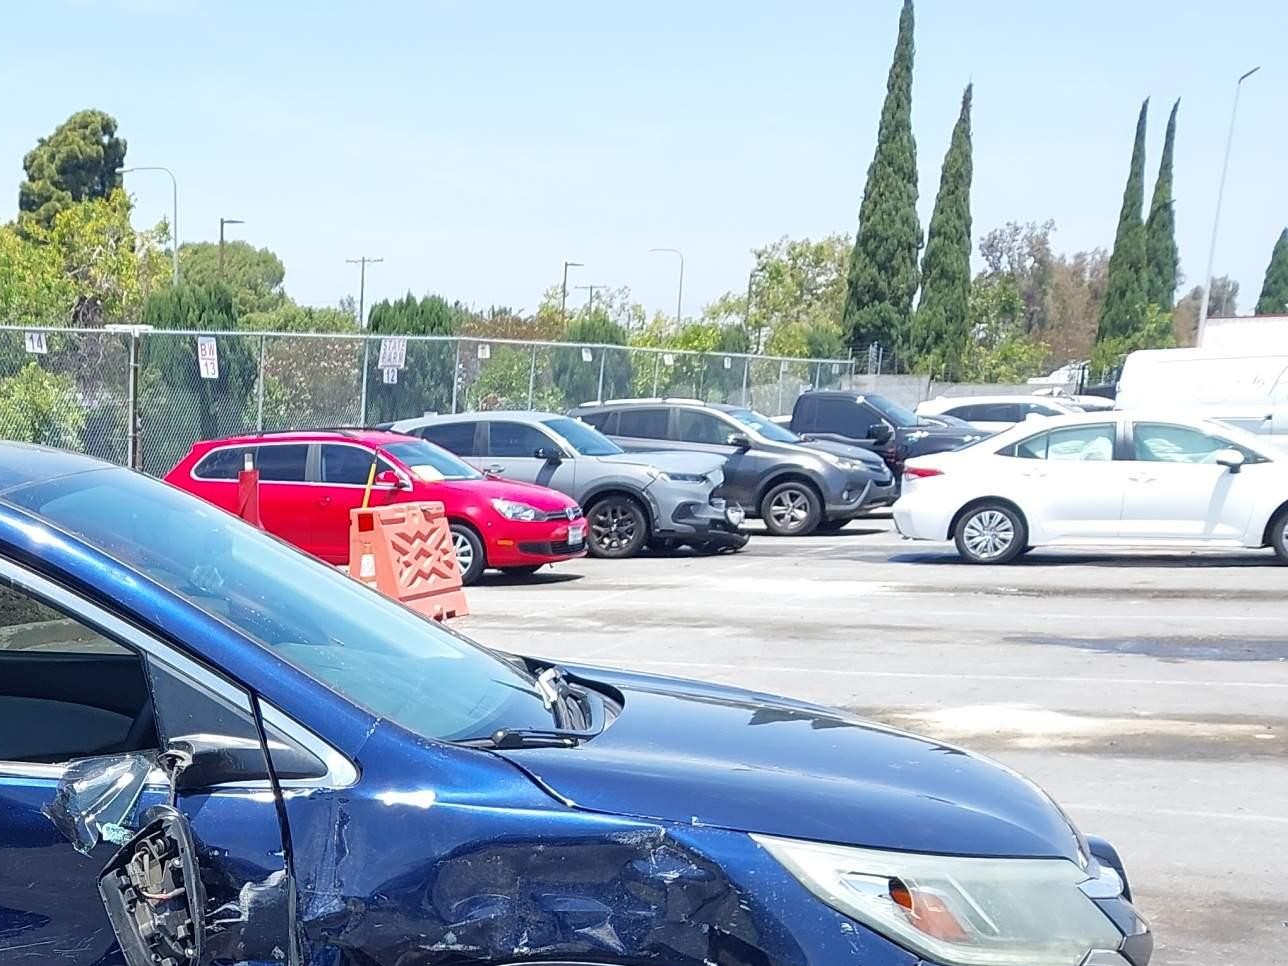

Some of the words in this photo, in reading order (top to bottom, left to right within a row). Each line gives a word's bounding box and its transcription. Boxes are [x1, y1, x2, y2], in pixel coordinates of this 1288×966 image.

[29, 334, 43, 351] 14
[200, 343, 215, 357] BW
[204, 361, 216, 375] 13
